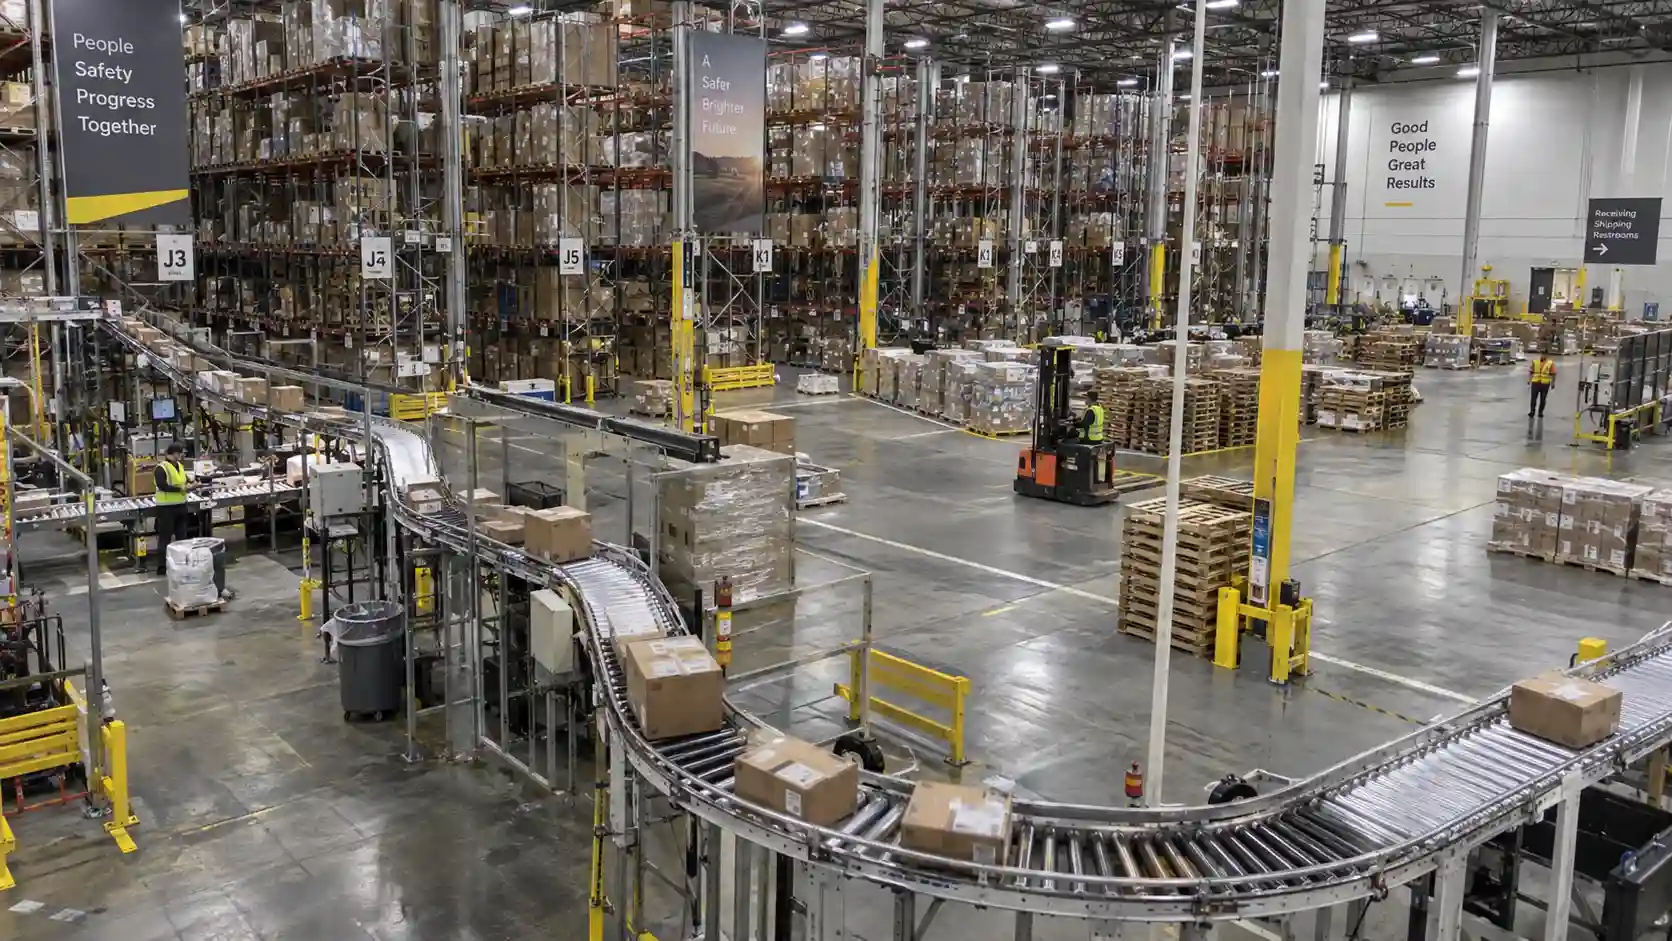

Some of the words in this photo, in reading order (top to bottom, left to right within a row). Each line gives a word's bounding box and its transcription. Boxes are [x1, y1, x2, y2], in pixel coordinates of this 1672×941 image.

[73, 32, 134, 56] People
[701, 53, 711, 68] A
[75, 60, 133, 84] Safety
[702, 75, 731, 91] Safer
[76, 88, 156, 110] Progress
[702, 98, 744, 116] Brighter
[77, 115, 157, 136] Together
[702, 120, 738, 135] Future
[1391, 119, 1428, 135] Good
[1389, 138, 1436, 155] People
[1388, 157, 1426, 171] Great
[1386, 175, 1436, 190] Results
[1594, 208, 1637, 219] Receiving
[1593, 219, 1632, 231] Shipping
[1593, 231, 1639, 240] Restrooms
[163, 249, 187, 267] J3
[366, 251, 386, 268] J4
[563, 249, 579, 264] J5
[756, 250, 769, 263] K1
[980, 249, 990, 261] K1
